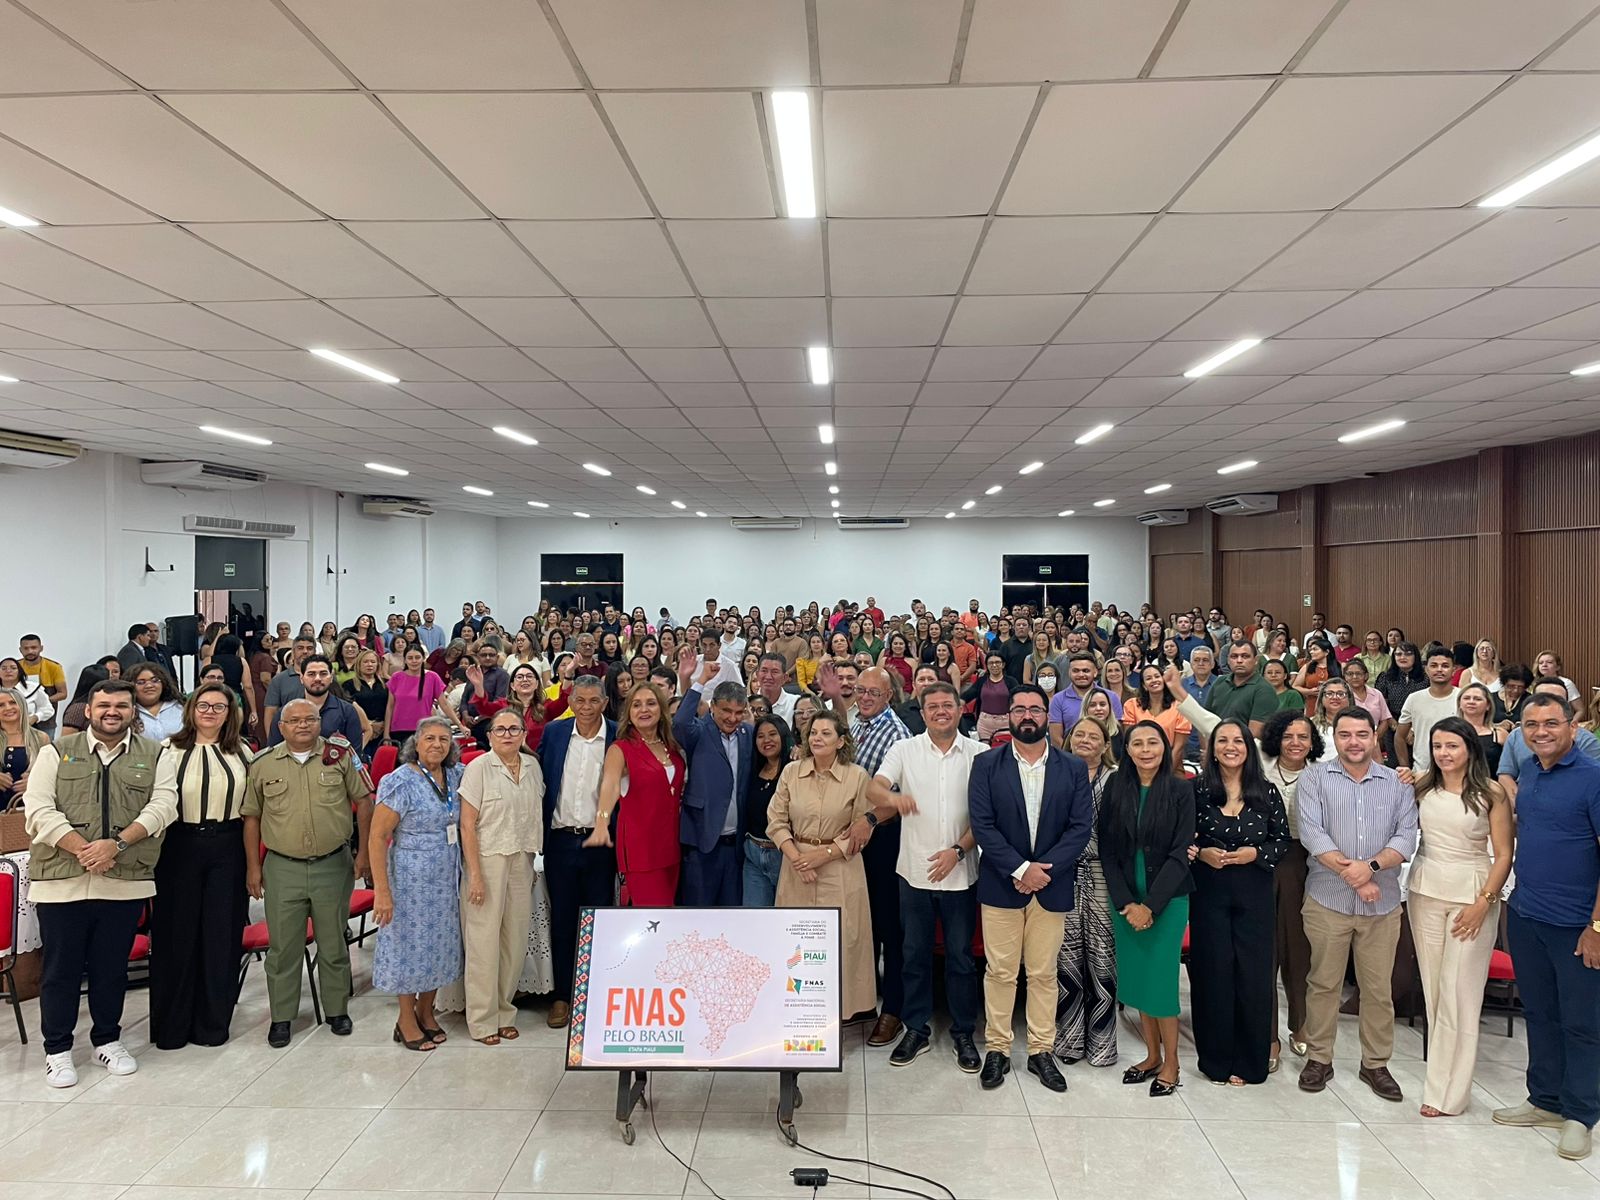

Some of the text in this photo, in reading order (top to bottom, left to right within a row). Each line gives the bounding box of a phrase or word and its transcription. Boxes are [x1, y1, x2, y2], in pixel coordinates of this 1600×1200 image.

[605, 988, 686, 1027] FNAS
[603, 1030, 685, 1042] PELO BRASIL
[784, 1040, 826, 1052] BRASIL
